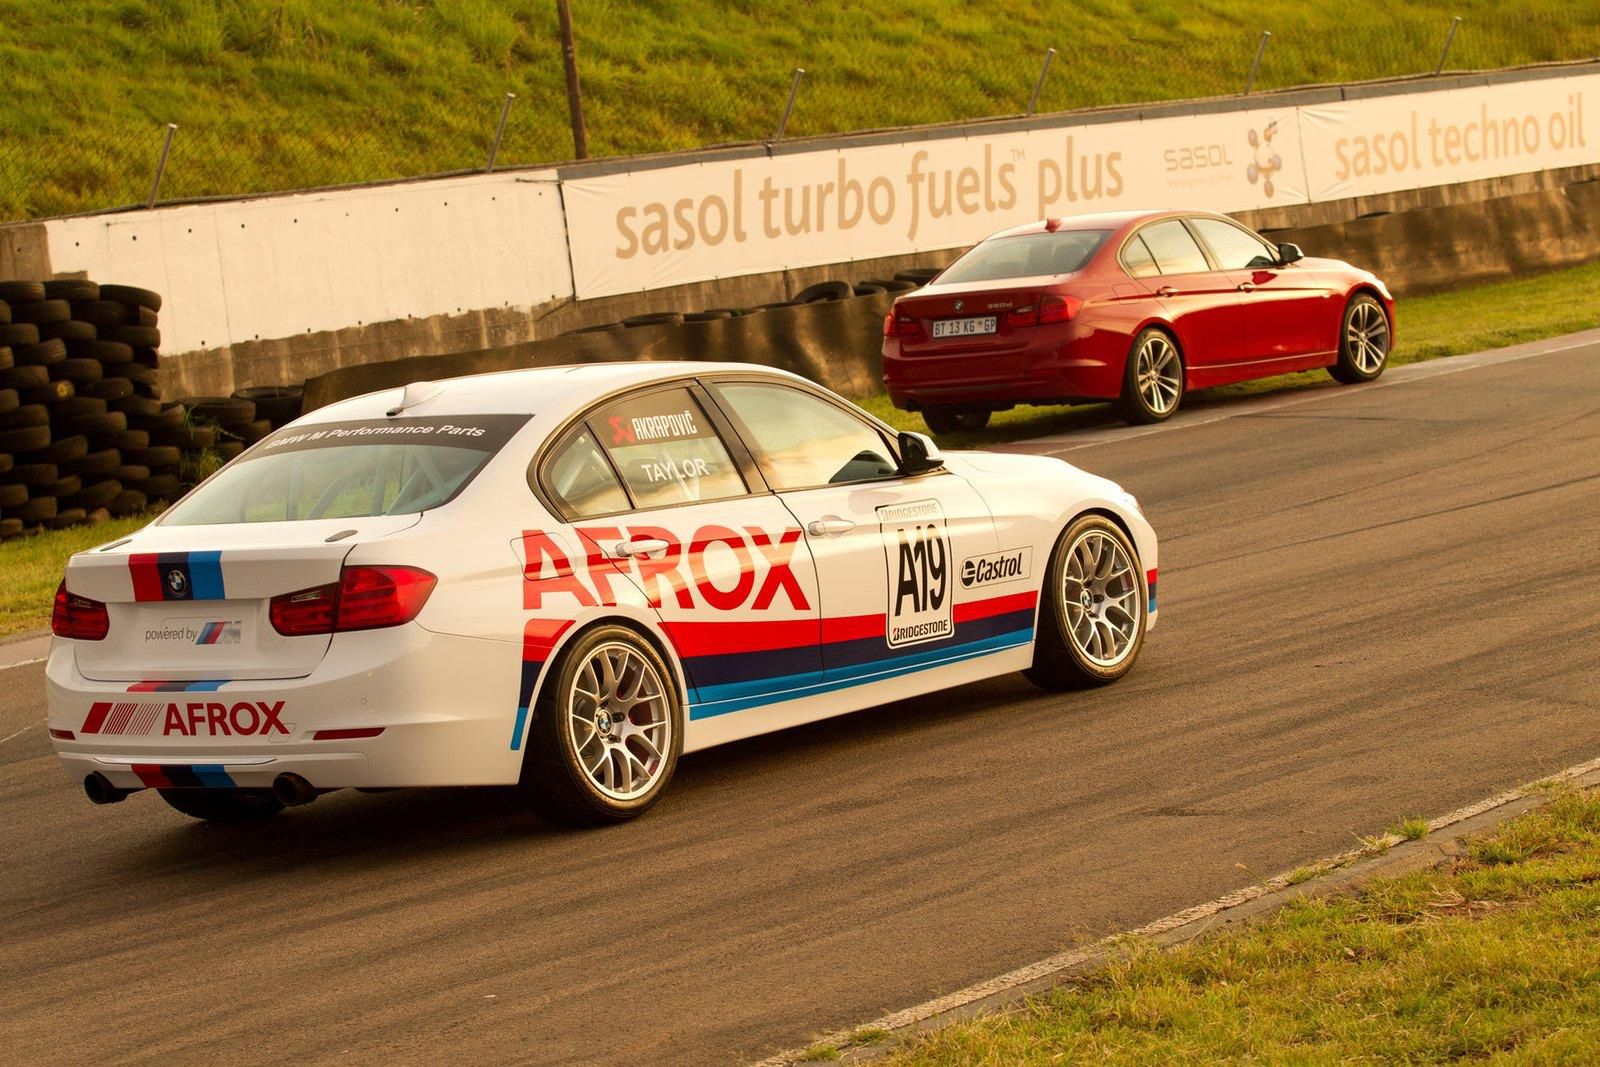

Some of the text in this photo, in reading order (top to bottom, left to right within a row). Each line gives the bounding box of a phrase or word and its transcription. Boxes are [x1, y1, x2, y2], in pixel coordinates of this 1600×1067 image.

[1335, 92, 1586, 181] sasol techno oil
[615, 169, 747, 259] sasol
[758, 158, 896, 239] turbo
[907, 144, 1017, 242] fuels
[1038, 135, 1124, 221] plus
[935, 317, 996, 336] BT 13 KG GP
[264, 425, 486, 449] BMW M Performance Parts
[641, 458, 710, 482] TAYLOR
[880, 503, 939, 521] BRIDGESTONE
[523, 525, 811, 610] AFROX
[895, 524, 946, 616] A19
[976, 552, 1022, 583] Castrol
[145, 627, 184, 642] powered
[187, 627, 198, 642] by
[893, 620, 948, 641] BRIDGESTONE
[163, 701, 290, 736] AFROX
